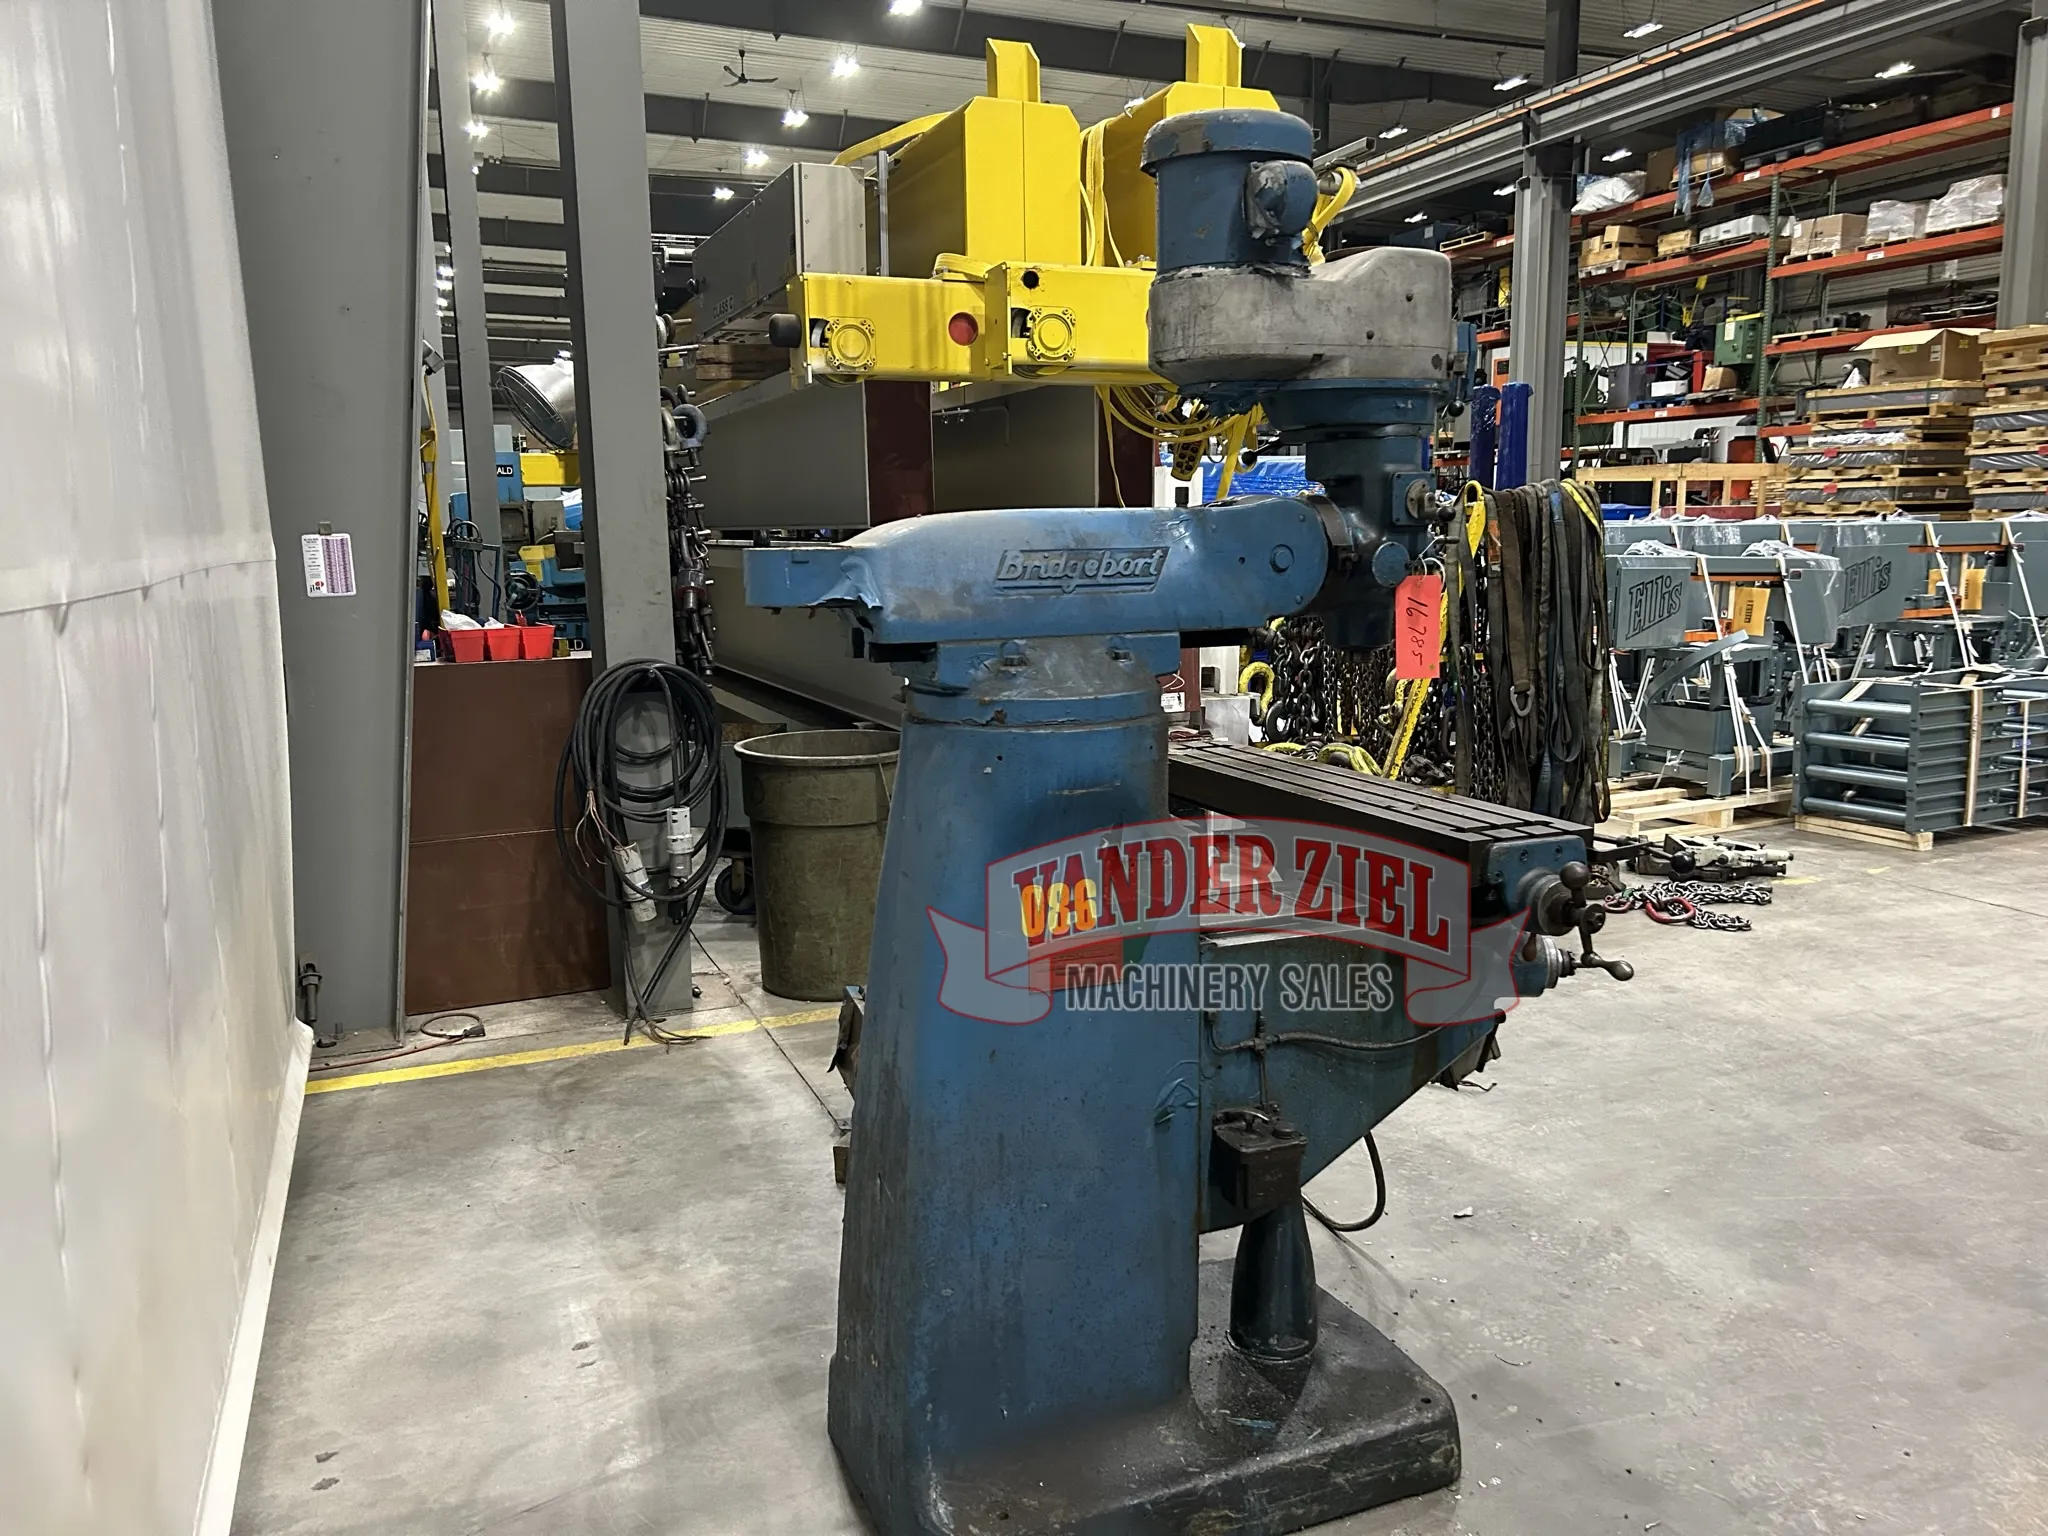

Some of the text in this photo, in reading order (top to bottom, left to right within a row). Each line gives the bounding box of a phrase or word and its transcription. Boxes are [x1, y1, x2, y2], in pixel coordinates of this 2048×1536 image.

[713, 299, 728, 320] CLASS
[996, 548, 1165, 595] Bridgeport
[1842, 555, 1892, 614] Ellis
[1625, 574, 1683, 640] Ellis
[1021, 878, 1097, 938] 086
